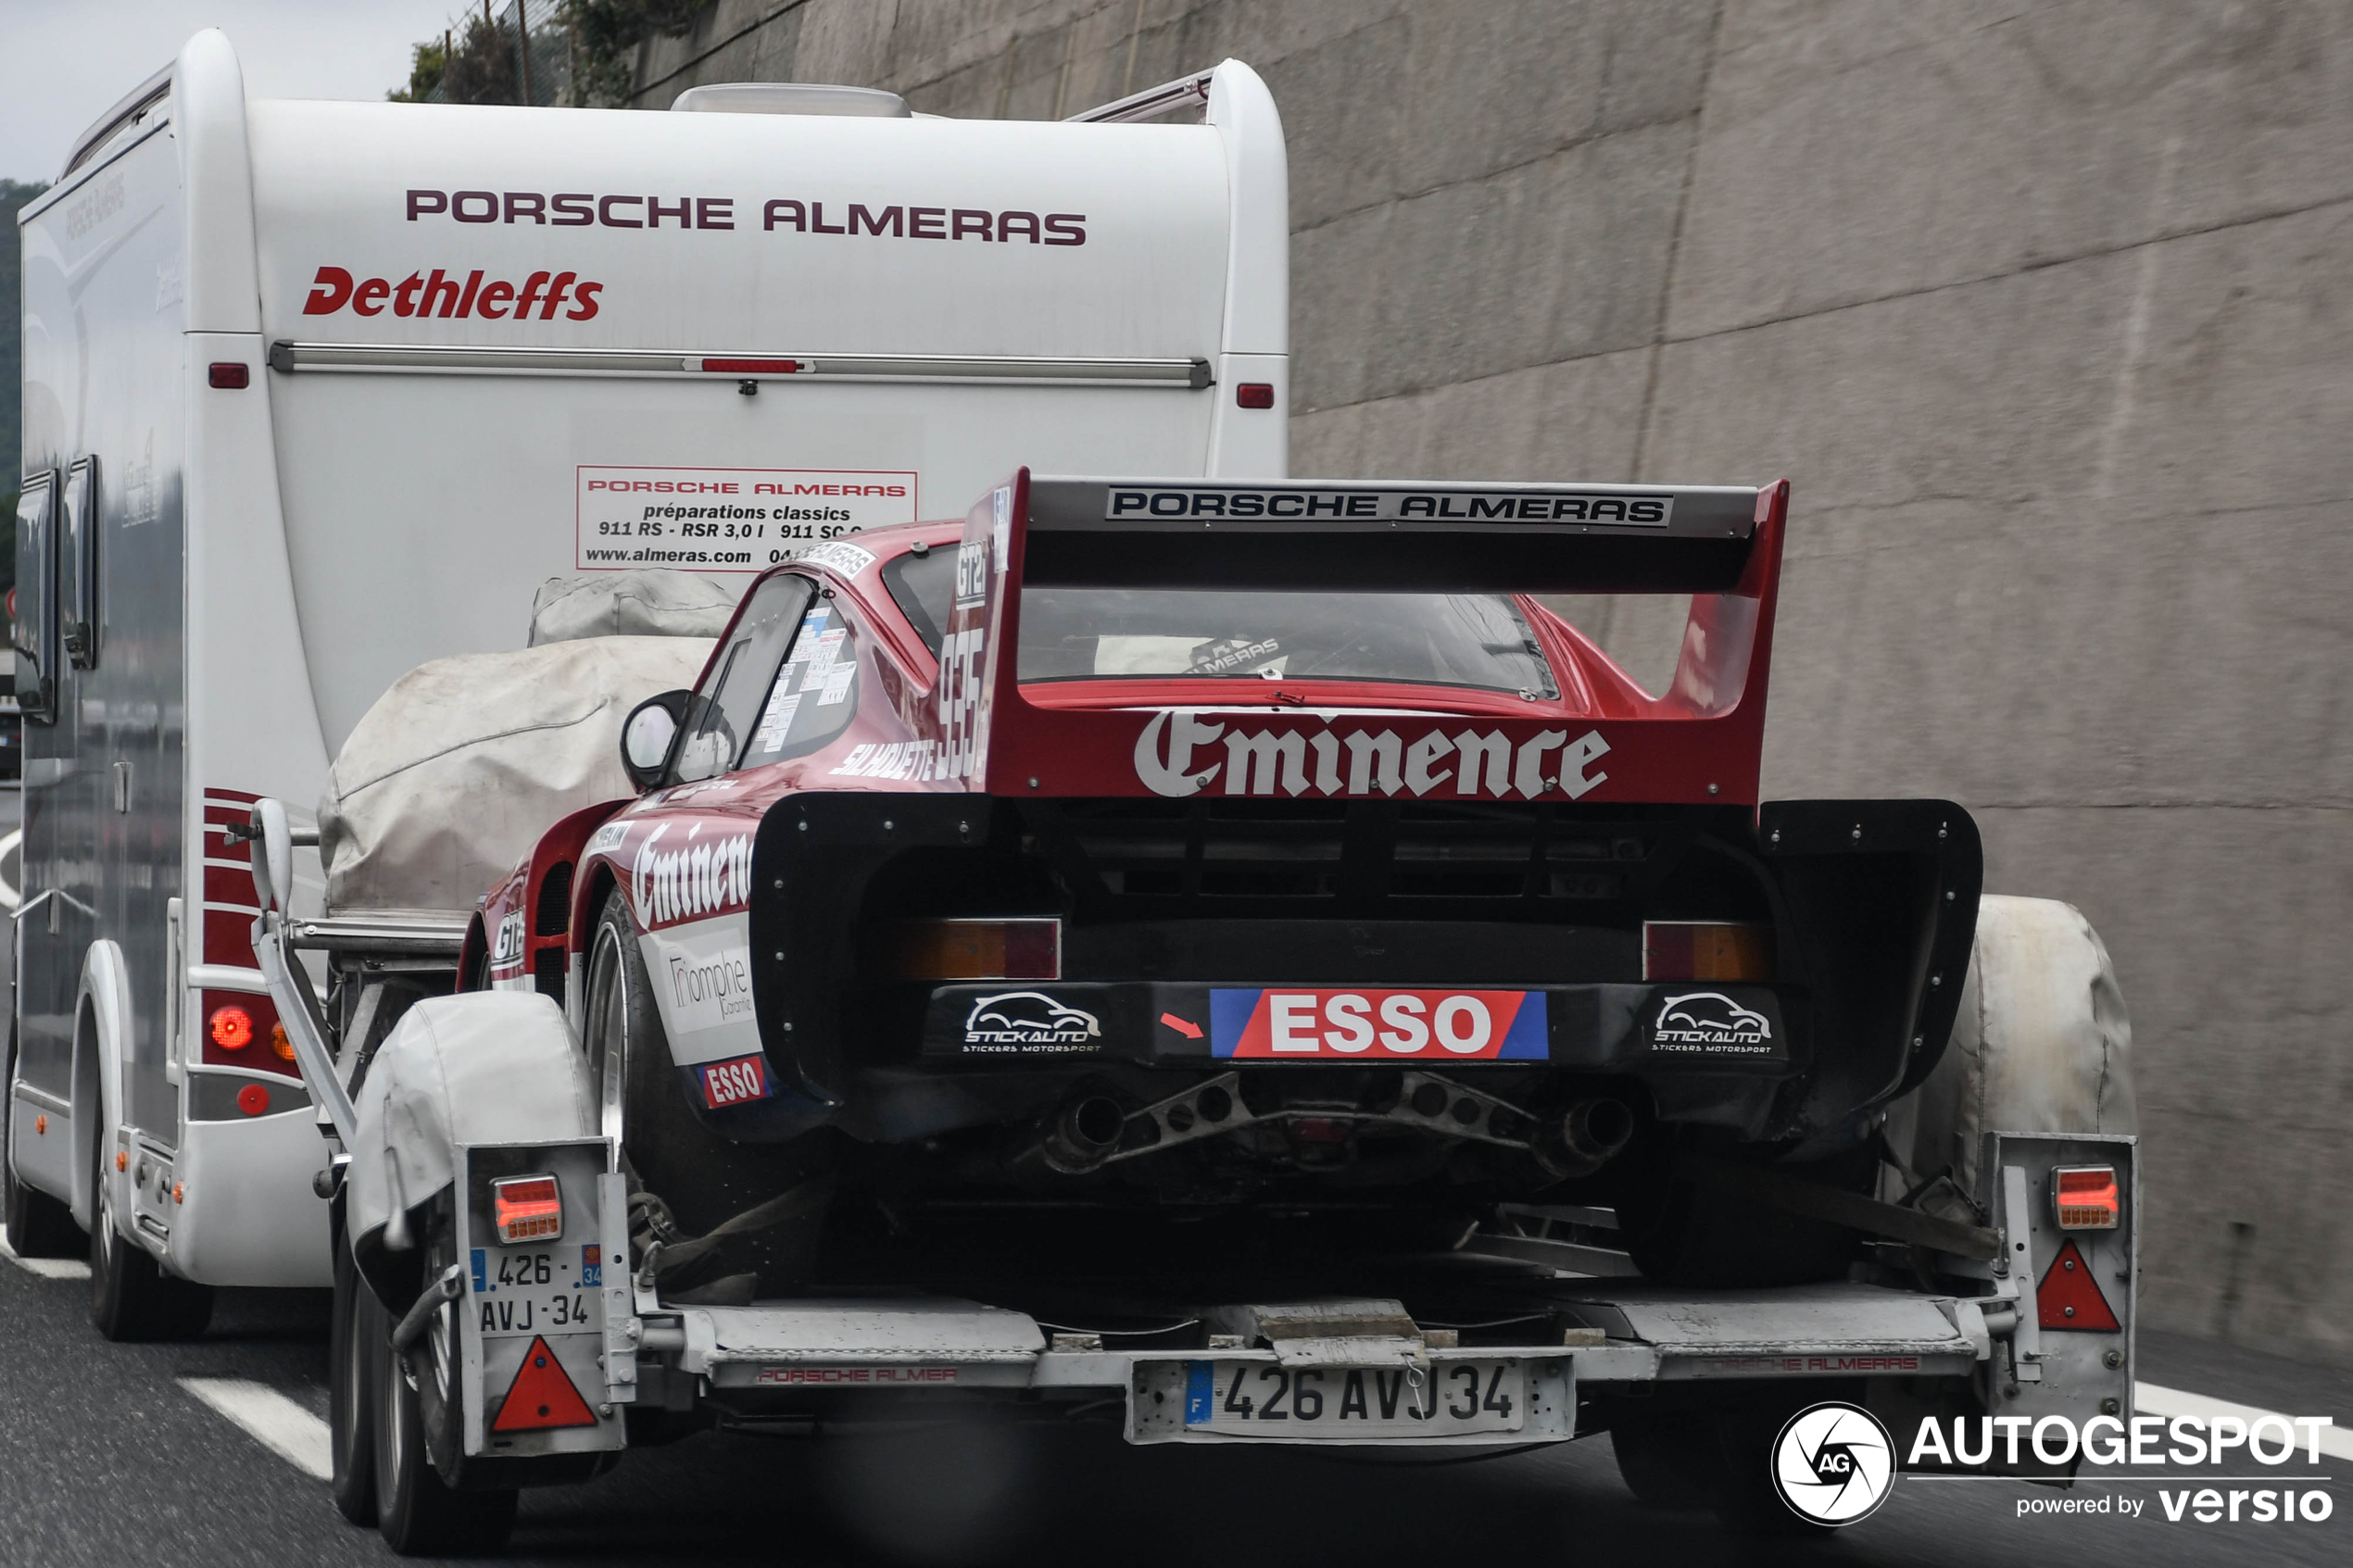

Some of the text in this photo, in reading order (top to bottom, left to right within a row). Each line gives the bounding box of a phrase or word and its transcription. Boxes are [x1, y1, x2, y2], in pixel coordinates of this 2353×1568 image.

[407, 189, 1087, 246] PORSCHE ALMERAS
[302, 266, 604, 321] Dethleffs
[587, 480, 906, 497] PORSCHE ALMERAS
[643, 502, 850, 521] préparations classics
[1112, 492, 1666, 522] PORSCHE ALMERAS
[598, 522, 632, 536] 911
[638, 522, 662, 537] RS
[682, 523, 719, 538] RSR
[724, 524, 752, 540] 3,0
[780, 524, 813, 539] 911
[586, 547, 751, 563] www.almeras.com
[935, 628, 984, 780] 935
[828, 740, 935, 781] SILHOUETTE
[1133, 710, 1612, 800] Eminence
[965, 1031, 1088, 1043] STICKAUTO
[1270, 994, 1491, 1054] ESSO
[1655, 1031, 1762, 1044] STICKAUTO
[1652, 1044, 1702, 1052] STICKERS
[706, 1061, 761, 1103] ESSO
[1808, 1358, 1919, 1371] ALMERAS
[1191, 1365, 1512, 1421] F 426 AVJ 34
